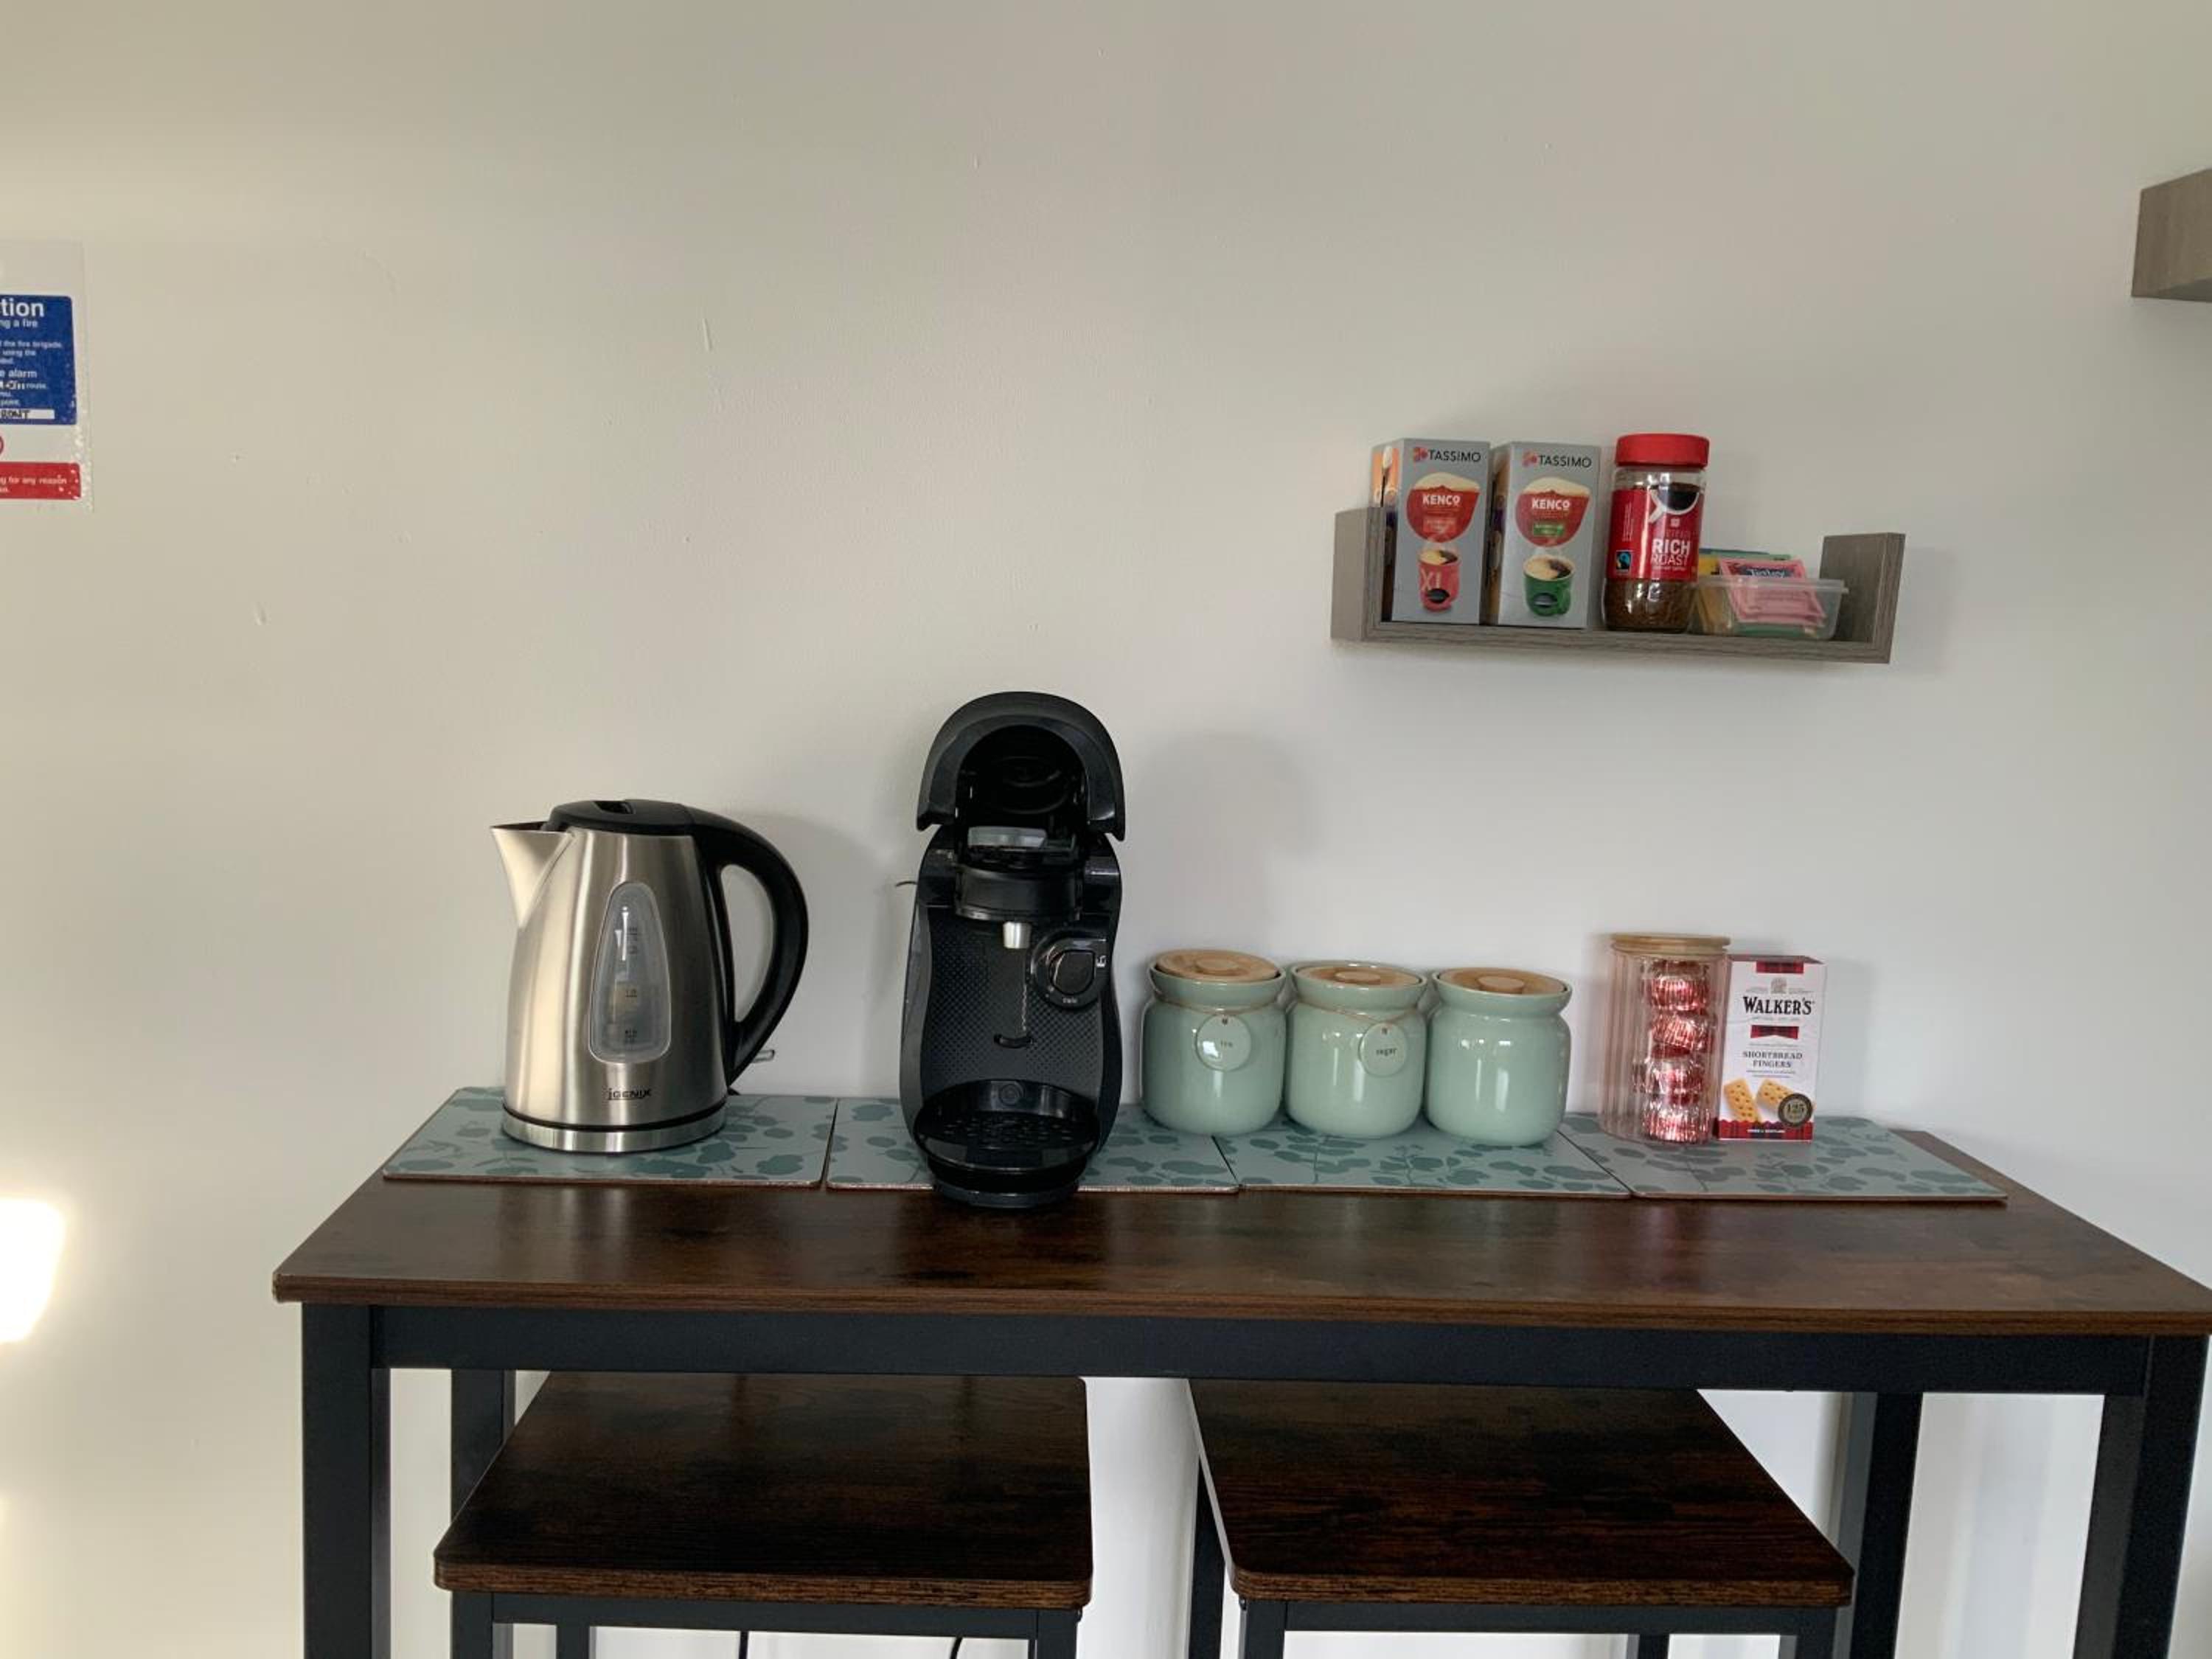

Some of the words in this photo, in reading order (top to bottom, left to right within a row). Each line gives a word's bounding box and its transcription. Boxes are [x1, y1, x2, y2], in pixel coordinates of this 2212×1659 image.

[13, 320, 20, 328] a
[22, 318, 38, 328] fire
[8, 368, 38, 378] alarm
[1427, 448, 1482, 464] TASSIMO
[1538, 454, 1593, 469] TASSIMO
[1422, 493, 1461, 507] KENCO
[1531, 498, 1571, 511] KENCO
[1652, 538, 1691, 556] RICH
[1651, 553, 1688, 567] ROAST
[1743, 996, 1812, 1016] WALKER'S
[1742, 1051, 1803, 1060] SHORTBREAD
[1753, 1060, 1792, 1068] FINGERS
